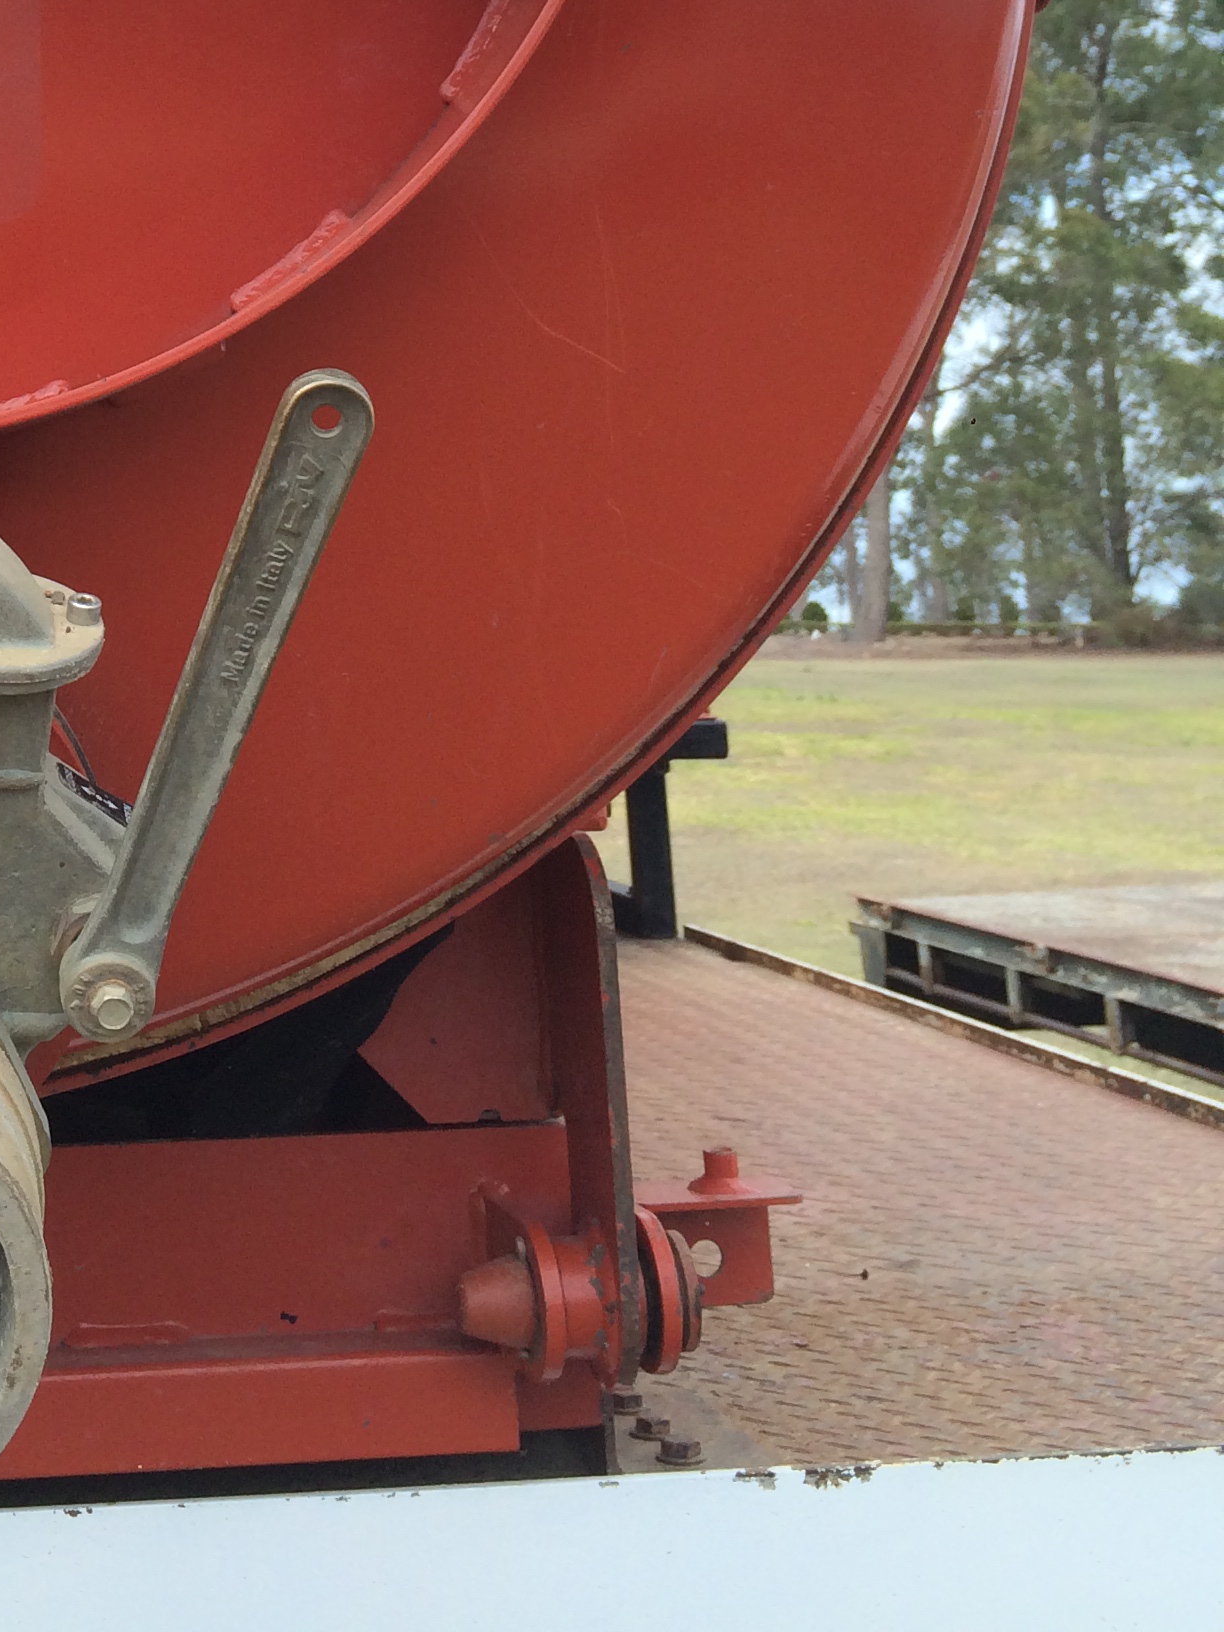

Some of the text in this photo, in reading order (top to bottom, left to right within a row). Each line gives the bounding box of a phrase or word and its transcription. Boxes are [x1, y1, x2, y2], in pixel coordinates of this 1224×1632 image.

[256, 539, 295, 592] Italy
[246, 595, 272, 619] in
[220, 622, 259, 682] Made
